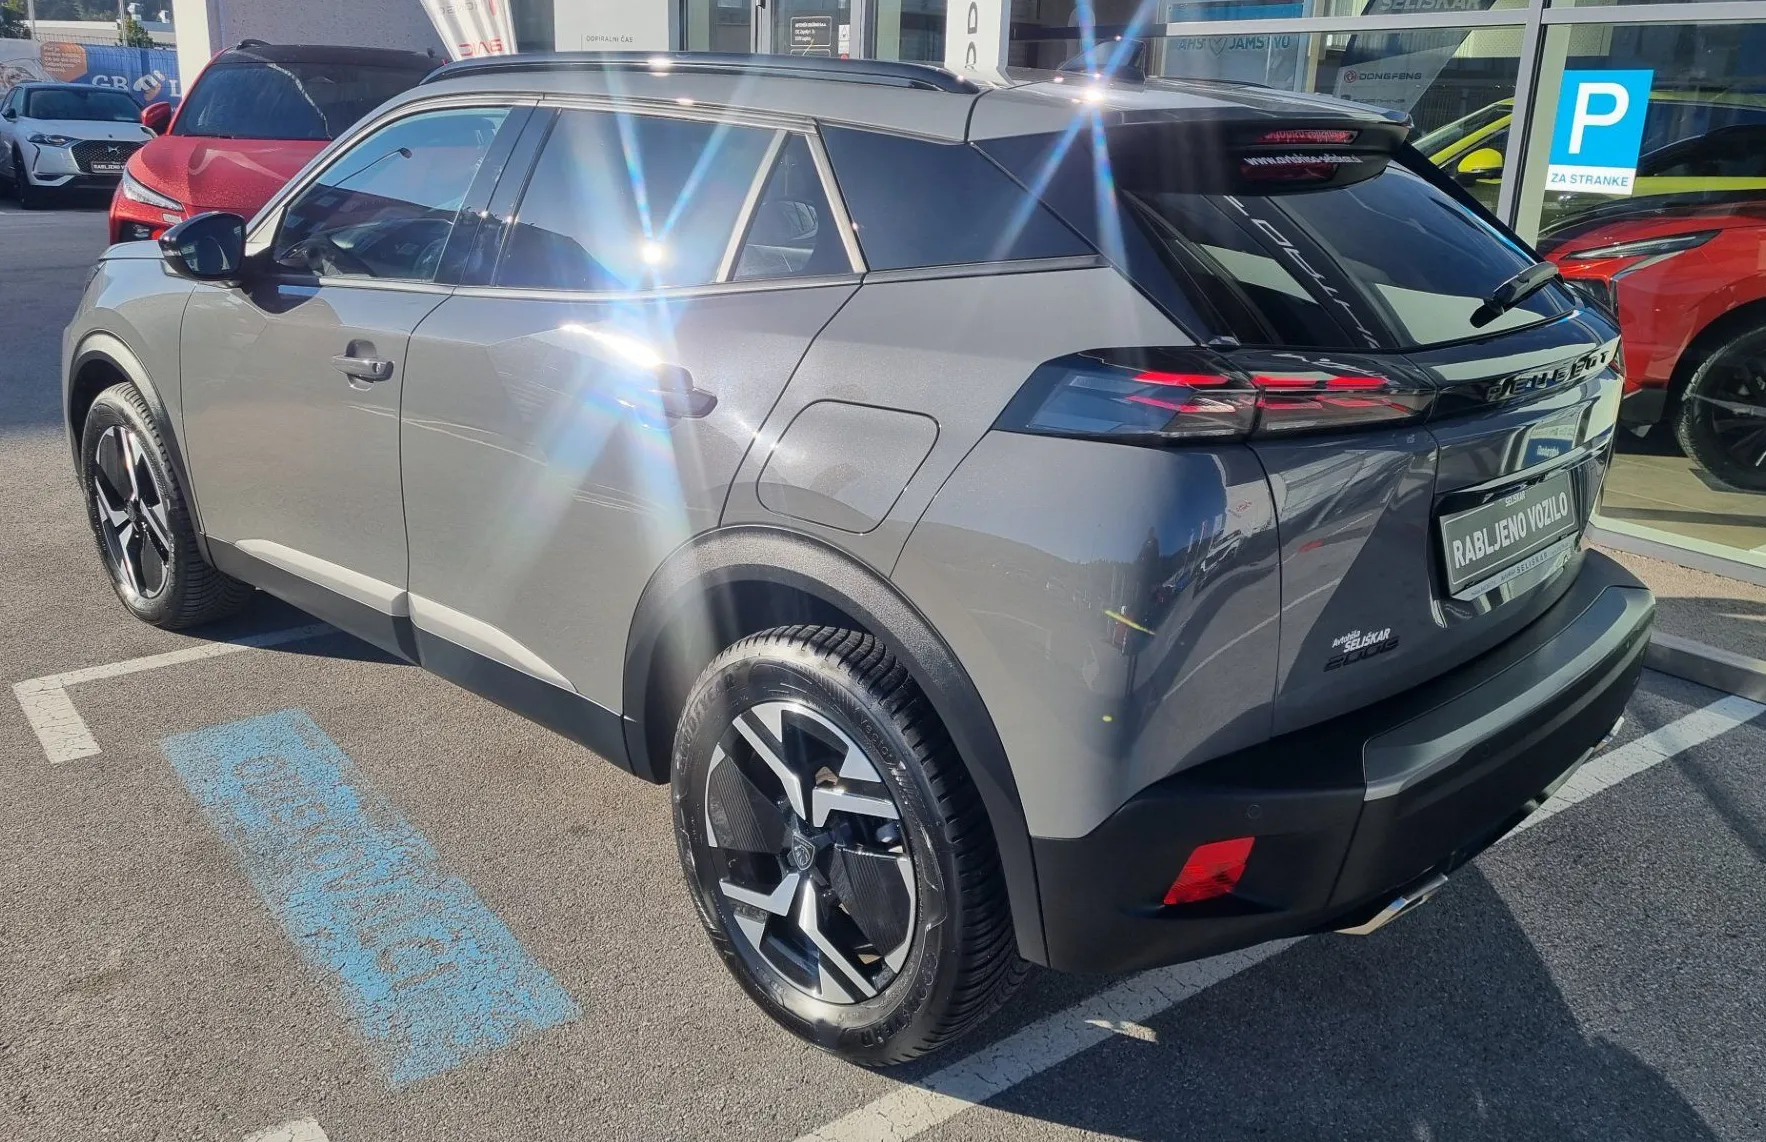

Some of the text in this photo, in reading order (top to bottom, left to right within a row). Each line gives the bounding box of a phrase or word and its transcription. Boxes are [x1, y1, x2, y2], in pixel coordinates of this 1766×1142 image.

[1358, 72, 1422, 81] DONGFENG
[1568, 82, 1630, 154] P
[1551, 172, 1629, 187] ZA STRANKE
[1452, 491, 1569, 569] RABLJENO VOZILO
[1343, 627, 1391, 653] SELIŠKAR
